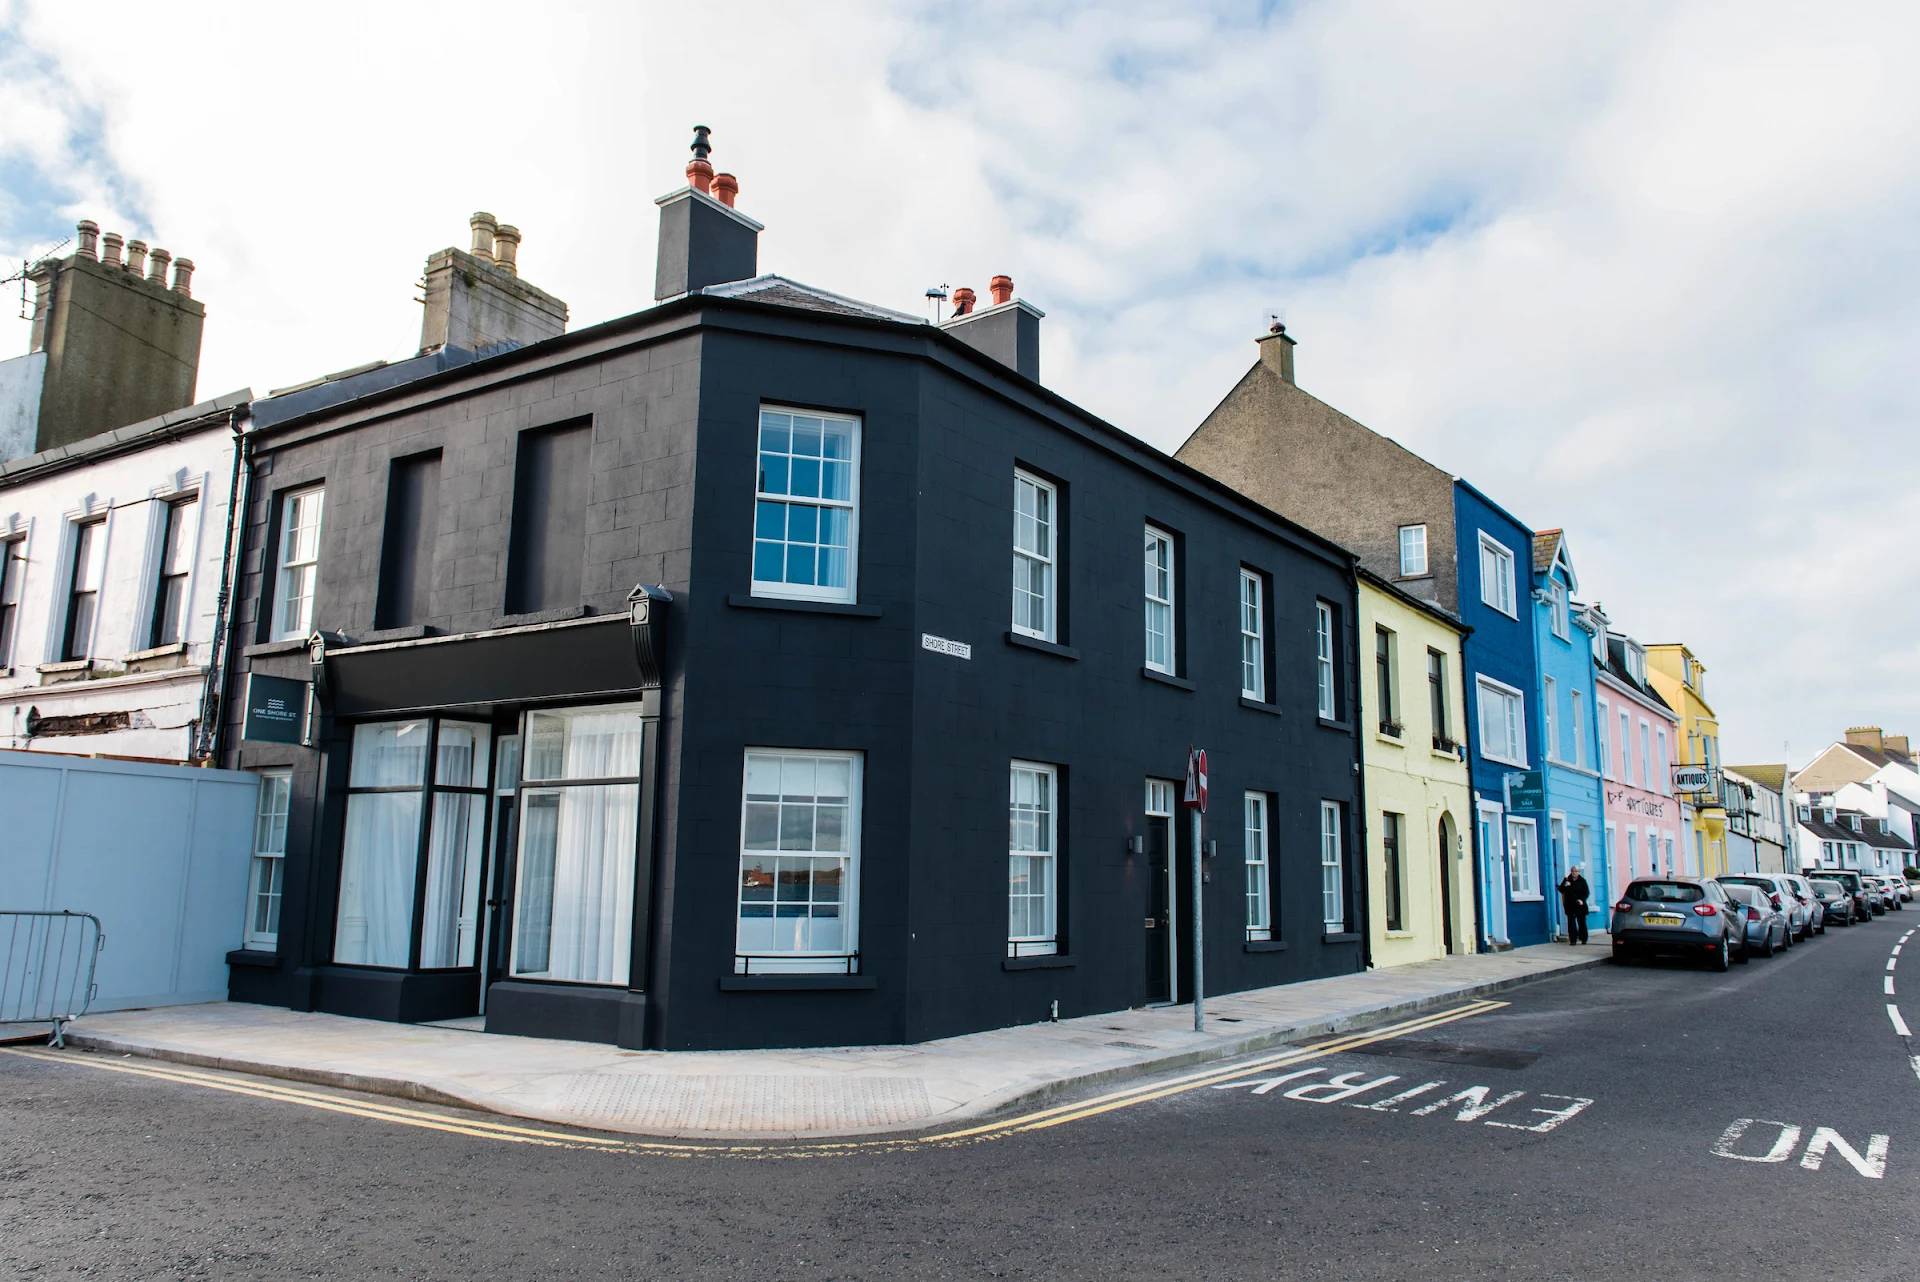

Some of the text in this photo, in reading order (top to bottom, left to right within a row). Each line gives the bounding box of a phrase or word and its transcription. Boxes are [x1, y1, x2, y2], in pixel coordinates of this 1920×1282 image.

[925, 637, 969, 657] SHORE STREET
[267, 709, 288, 717] SHORE
[1676, 773, 1707, 785] ANTIQUES
[1211, 1066, 1890, 1179] NO ENTRY
